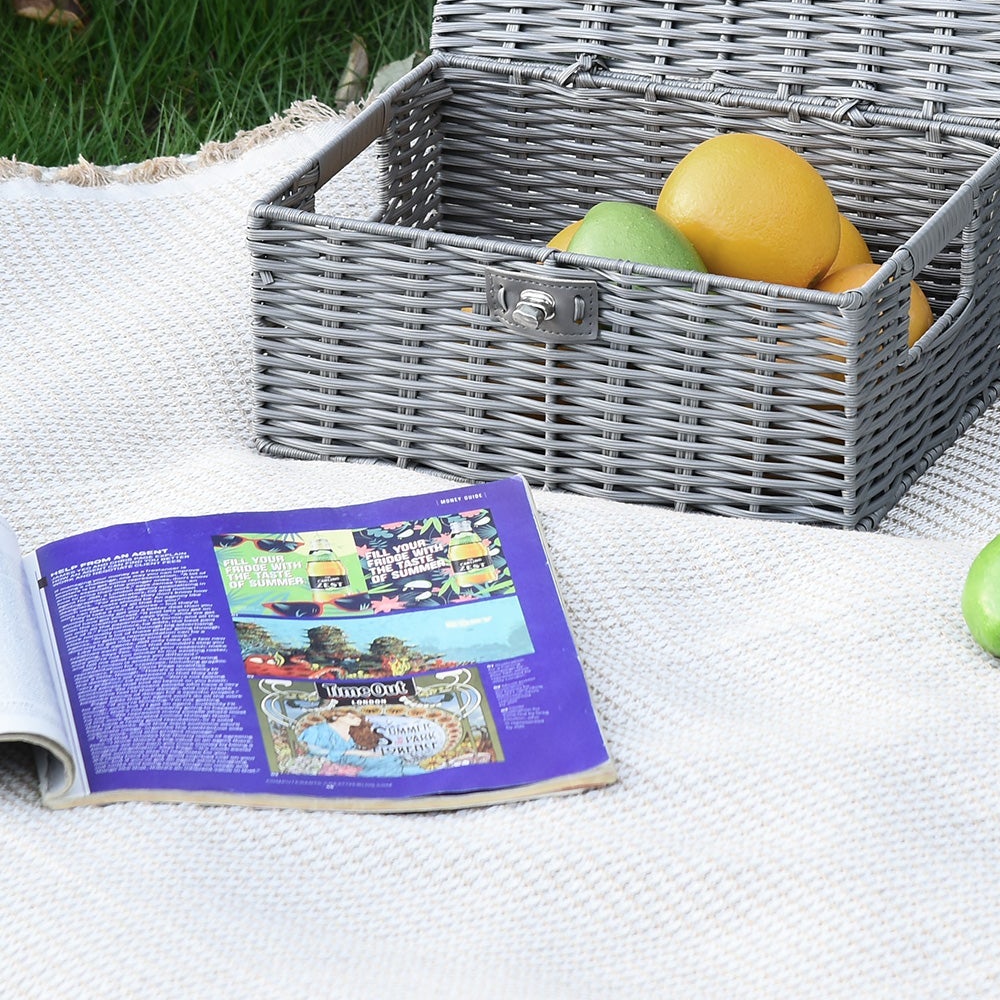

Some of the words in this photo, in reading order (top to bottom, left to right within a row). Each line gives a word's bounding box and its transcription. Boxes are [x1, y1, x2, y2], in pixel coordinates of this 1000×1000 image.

[440, 496, 462, 505] MONEY
[464, 492, 483, 501] GUIDE
[365, 548, 390, 560] FILL
[393, 539, 426, 553] YOUR
[366, 553, 409, 568] FRIDGE
[412, 544, 444, 558] WITH
[50, 564, 78, 577] HELP
[80, 556, 111, 568] FROM
[113, 552, 129, 561] AN
[131, 548, 168, 557] AGENT
[223, 558, 249, 568] FILL
[253, 555, 285, 564] YOUR
[225, 564, 268, 574] FRIDGE
[272, 561, 301, 572] WITH
[368, 563, 394, 575] THE
[397, 554, 435, 569] TASTE
[227, 573, 252, 582] THE
[255, 570, 294, 580] TASTE
[370, 572, 388, 584] OF
[229, 580, 245, 589] OF
[351, 698, 387, 706] LONDON
